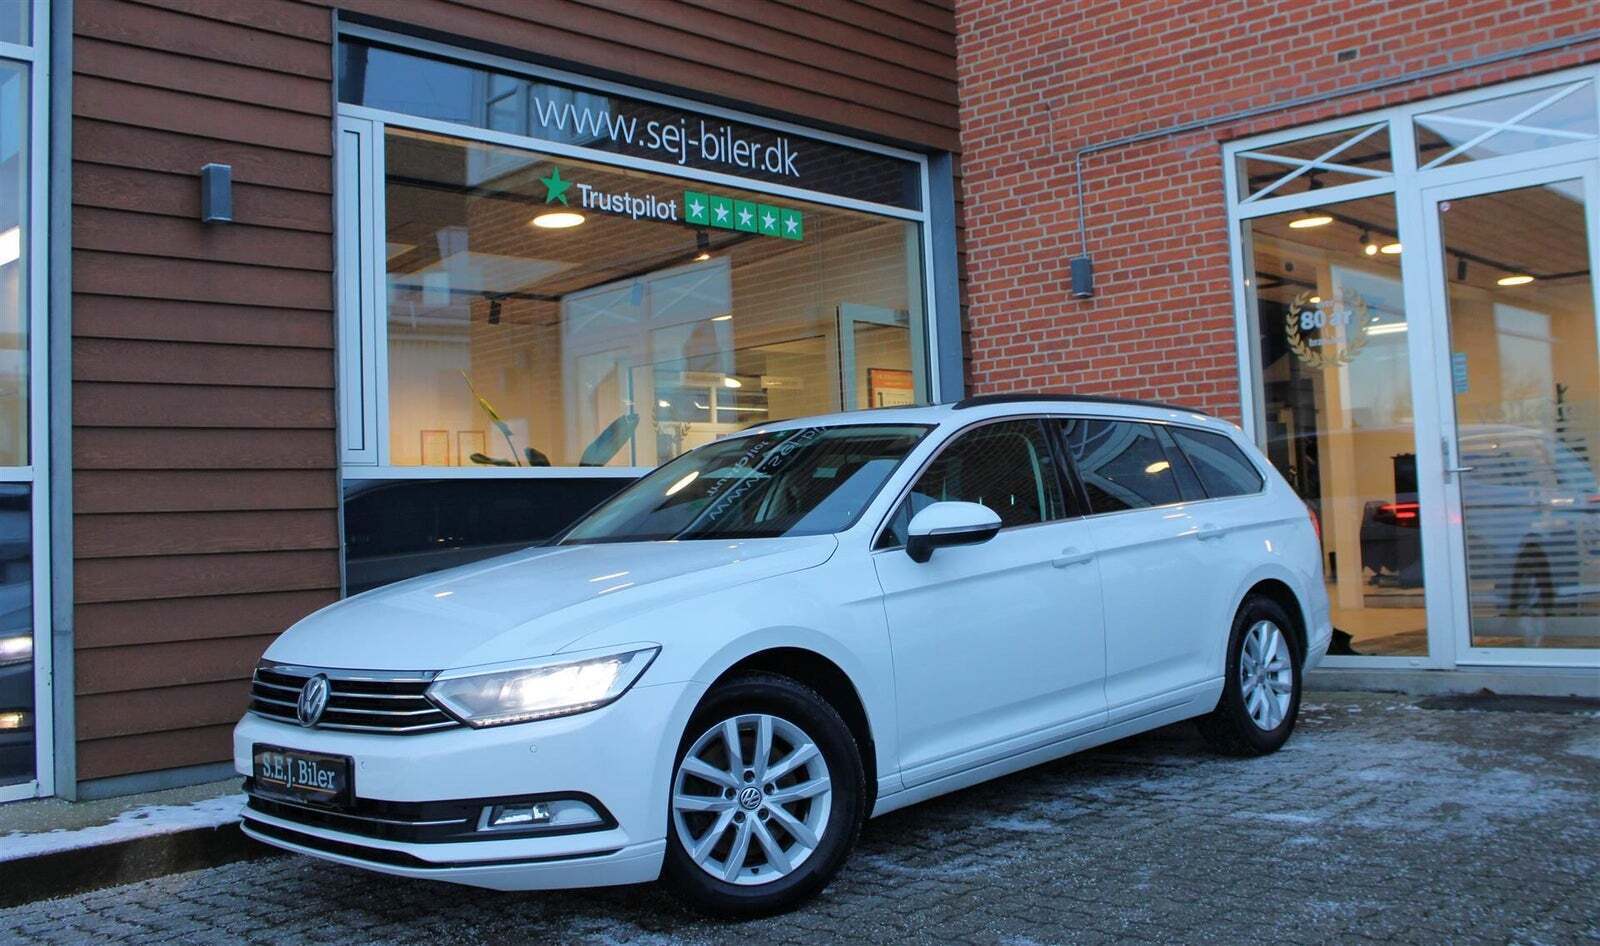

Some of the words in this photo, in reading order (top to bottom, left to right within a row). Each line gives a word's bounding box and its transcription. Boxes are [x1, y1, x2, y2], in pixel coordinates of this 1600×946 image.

[534, 97, 799, 177] www.sej-biler.dk
[577, 184, 678, 222] Trustpilot
[1300, 310, 1327, 330] 80
[263, 753, 297, 788] S.E.J.
[299, 760, 336, 788] Biler
